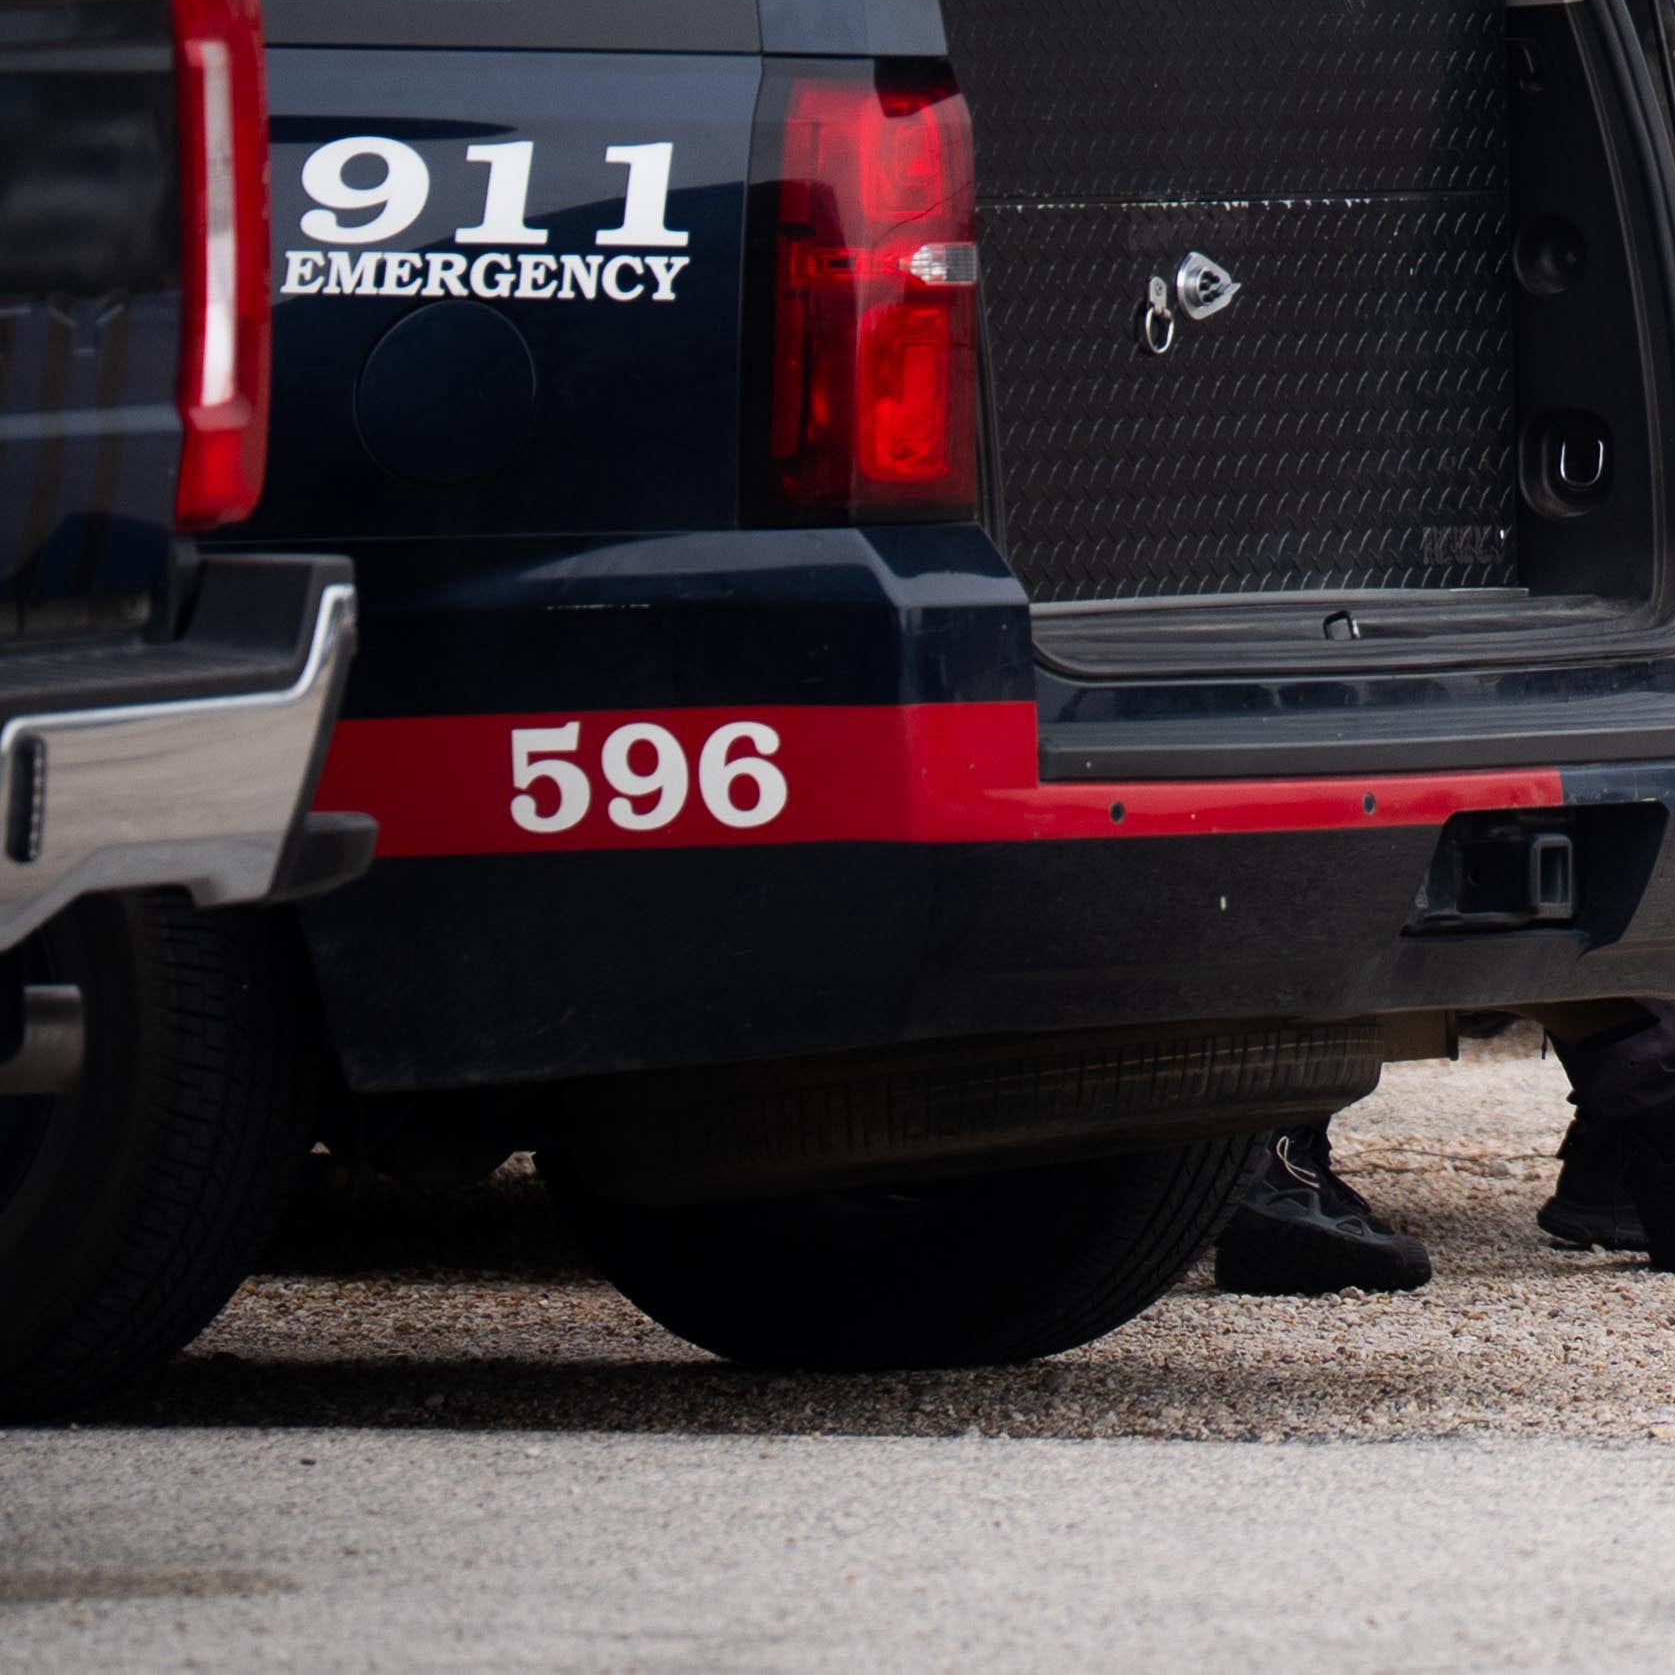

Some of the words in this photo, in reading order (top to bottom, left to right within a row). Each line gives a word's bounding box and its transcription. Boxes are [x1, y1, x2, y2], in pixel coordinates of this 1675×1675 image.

[299, 136, 690, 246] 911
[281, 250, 690, 301] EMERGENCY
[509, 721, 788, 834] 596
